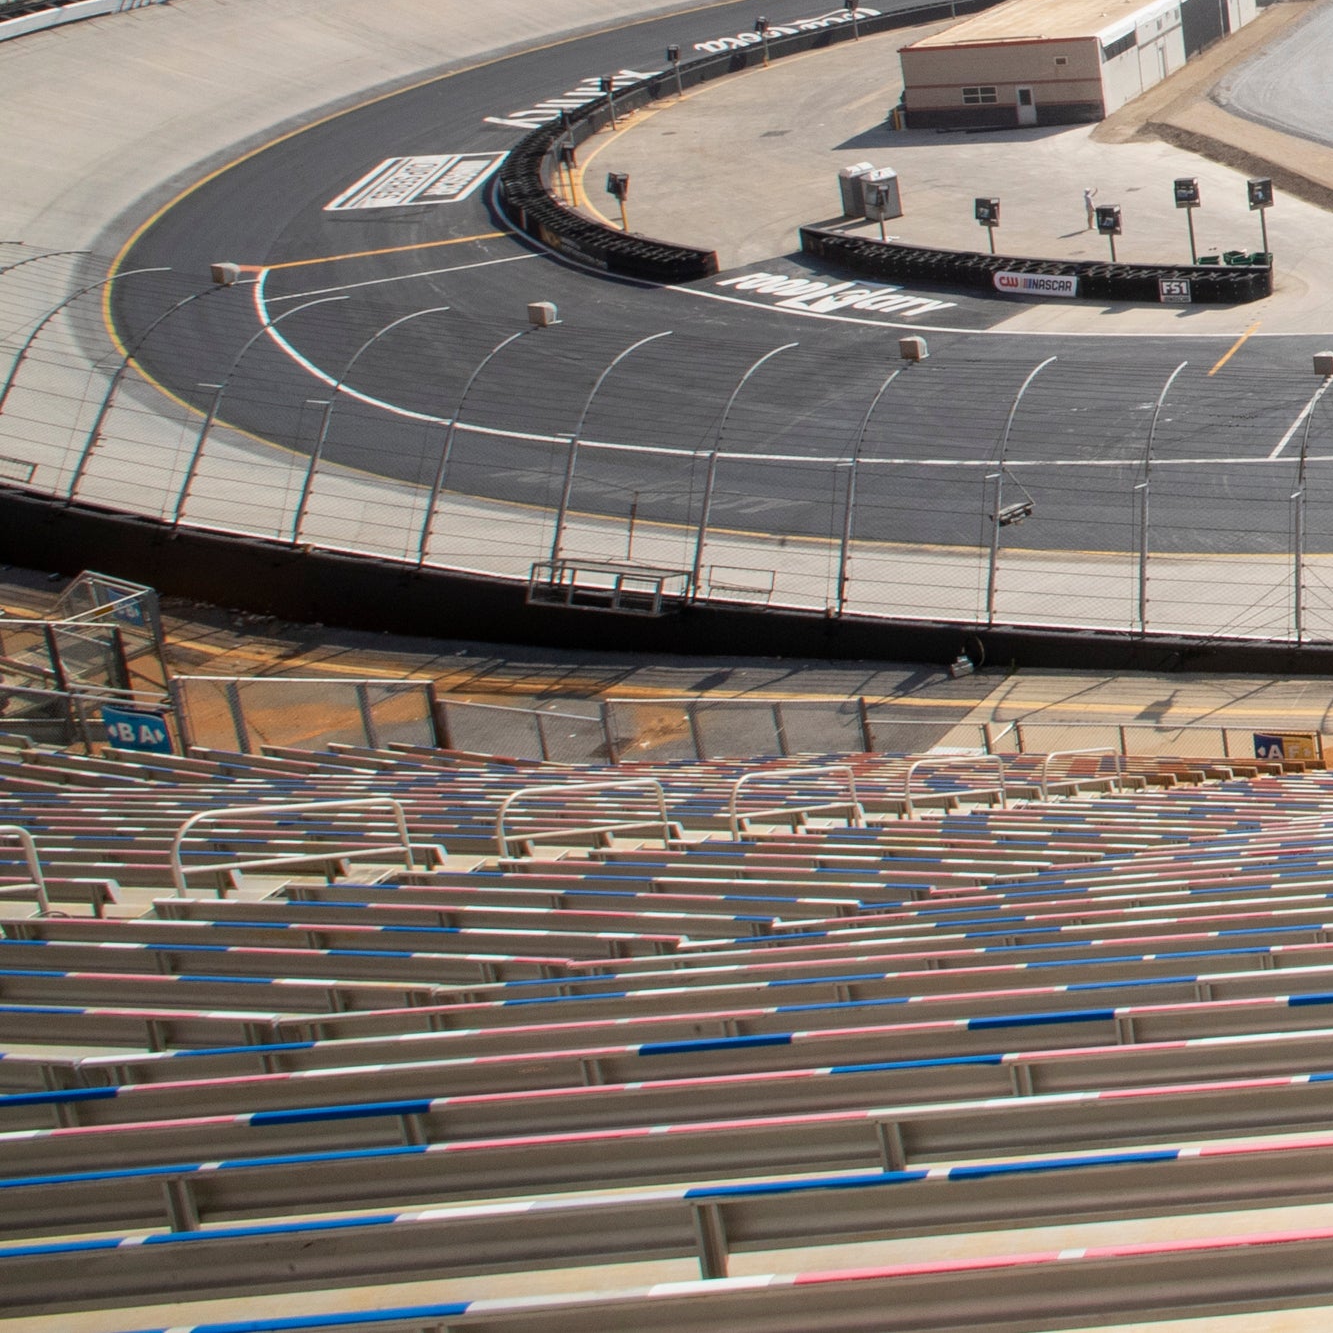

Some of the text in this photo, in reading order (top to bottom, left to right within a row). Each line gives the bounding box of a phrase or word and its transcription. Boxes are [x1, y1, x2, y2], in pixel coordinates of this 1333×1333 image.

[999, 275, 1073, 292] CW NASCAR
[1163, 281, 1188, 294] FS1
[117, 722, 154, 744] B A
[1268, 744, 1284, 759] A
